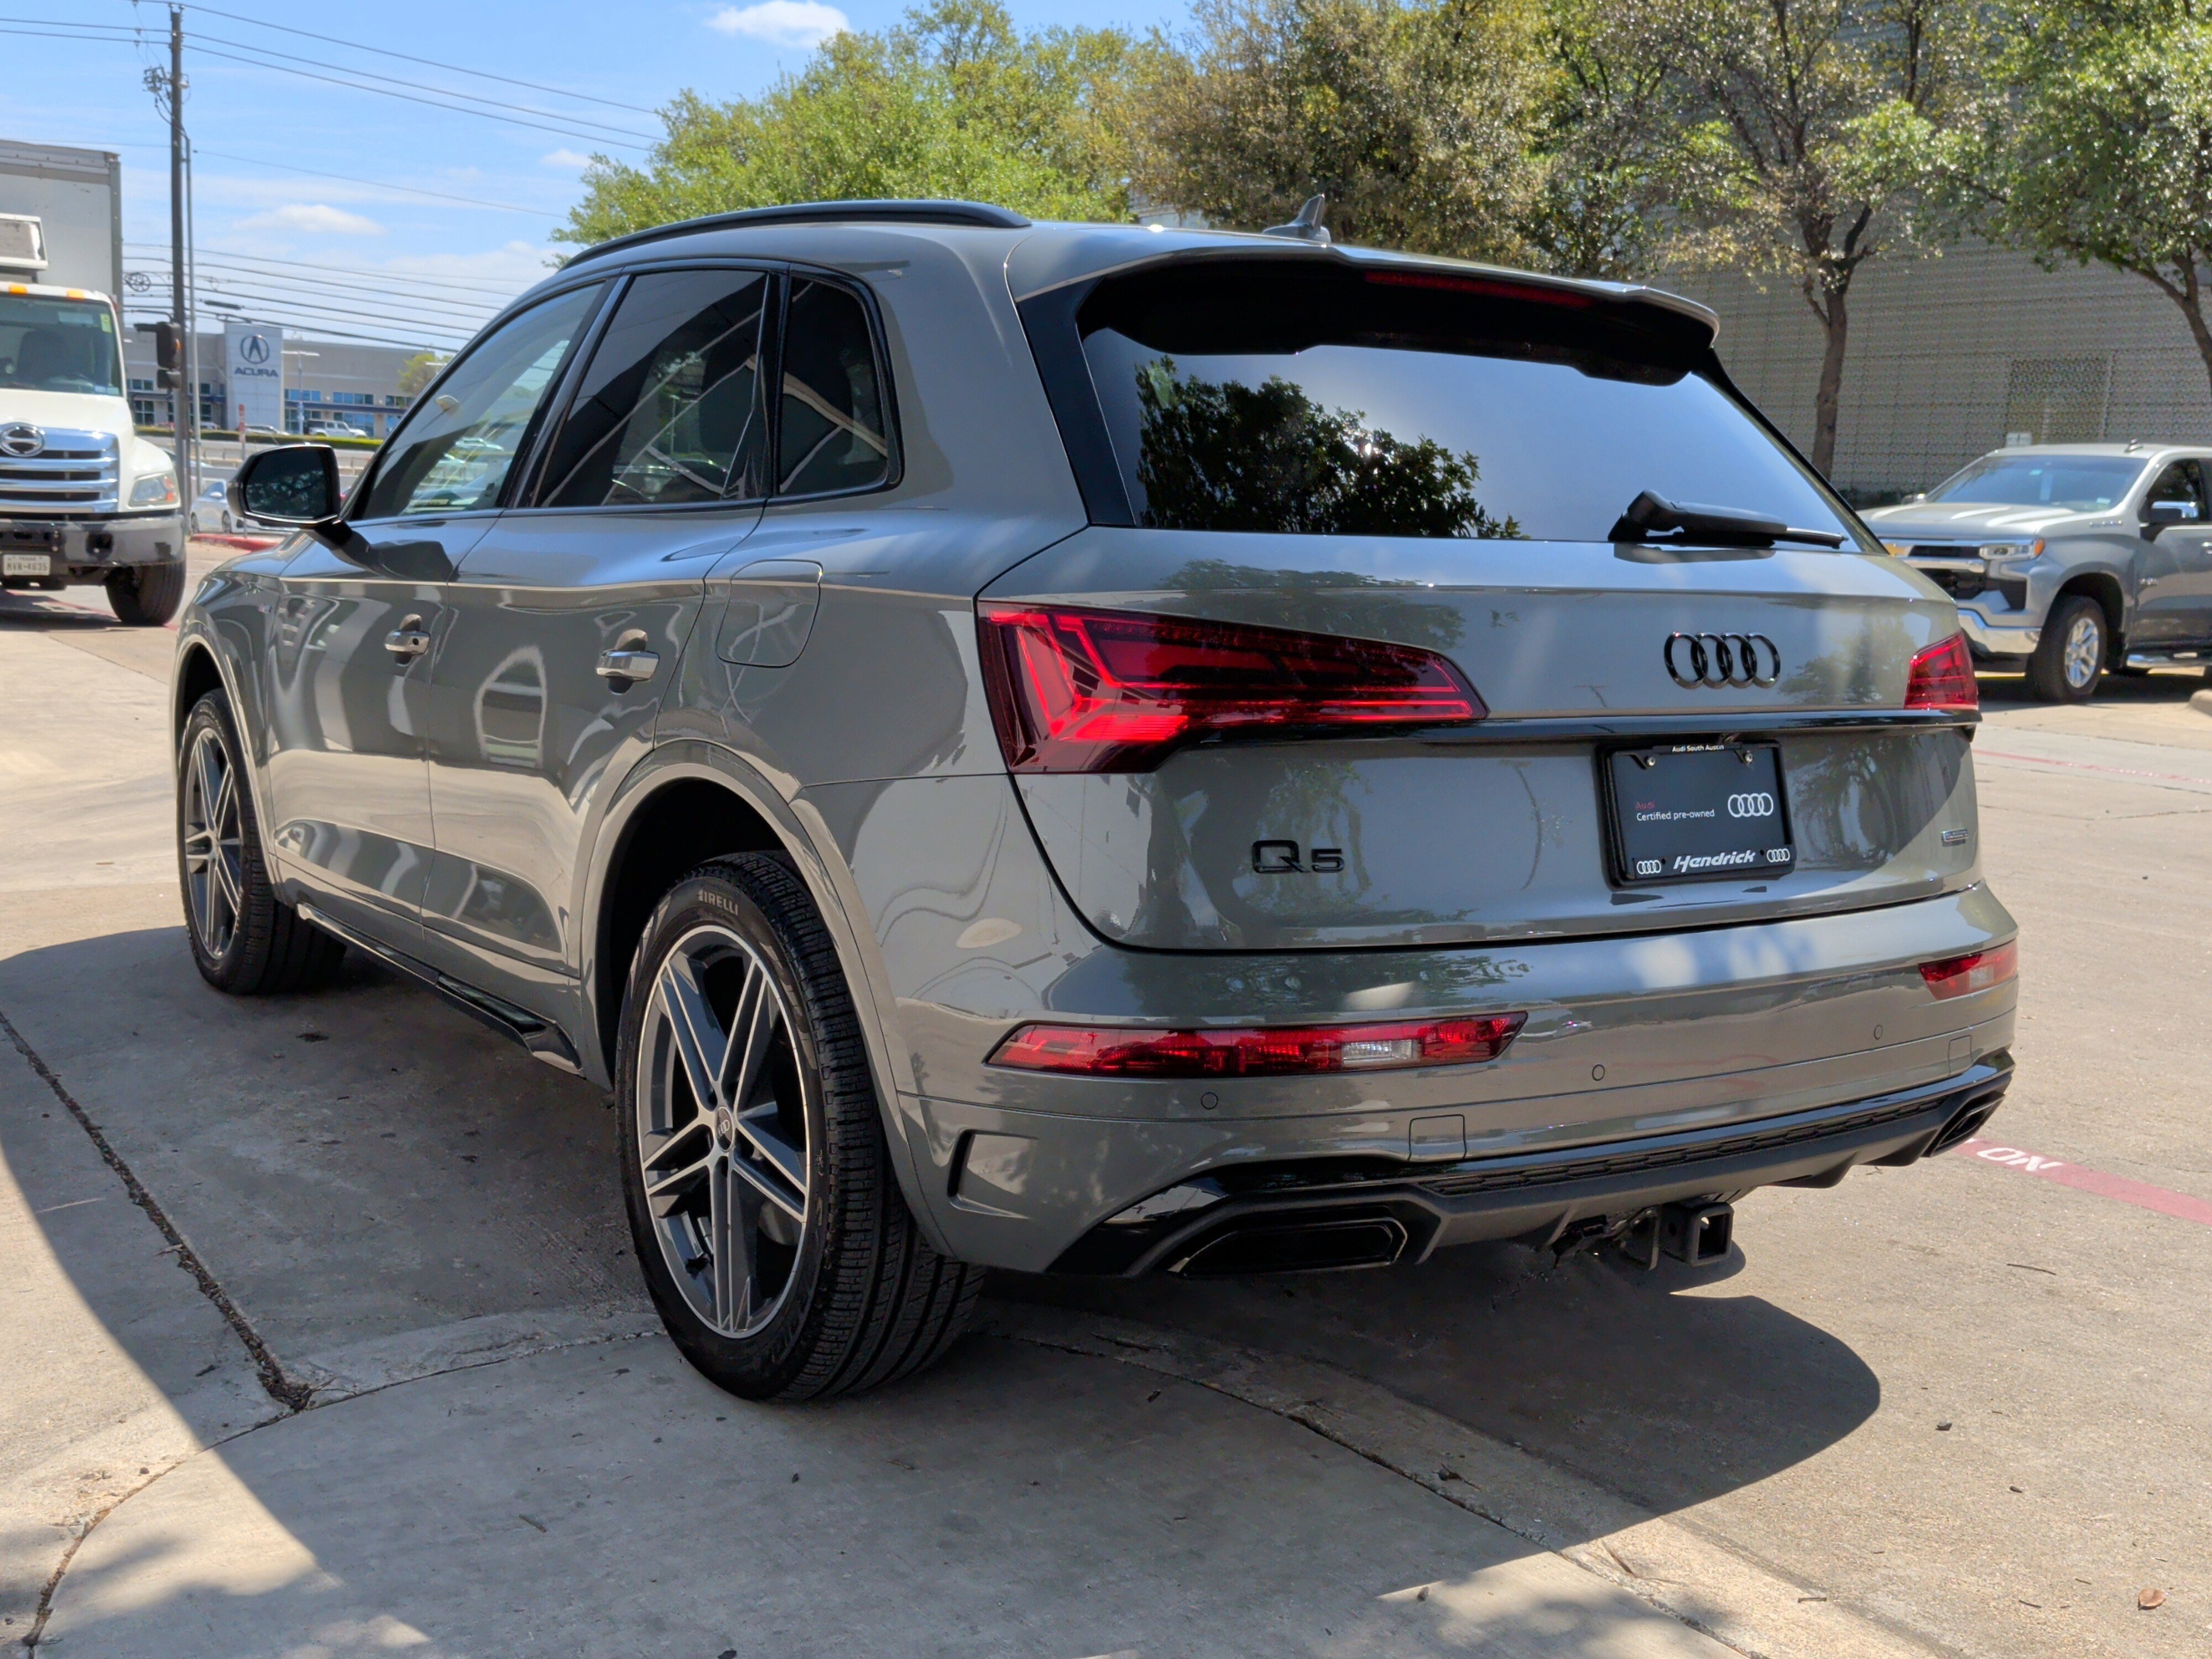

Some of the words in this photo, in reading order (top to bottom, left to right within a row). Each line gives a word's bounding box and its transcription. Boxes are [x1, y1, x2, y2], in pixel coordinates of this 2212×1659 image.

[234, 367, 279, 377] ACURA
[1635, 801, 1656, 810] Audi
[1636, 811, 1671, 821] Certified
[1673, 808, 1715, 820] pre-owned
[1252, 839, 1345, 874] Q5
[1672, 849, 1756, 873] Hendrick
